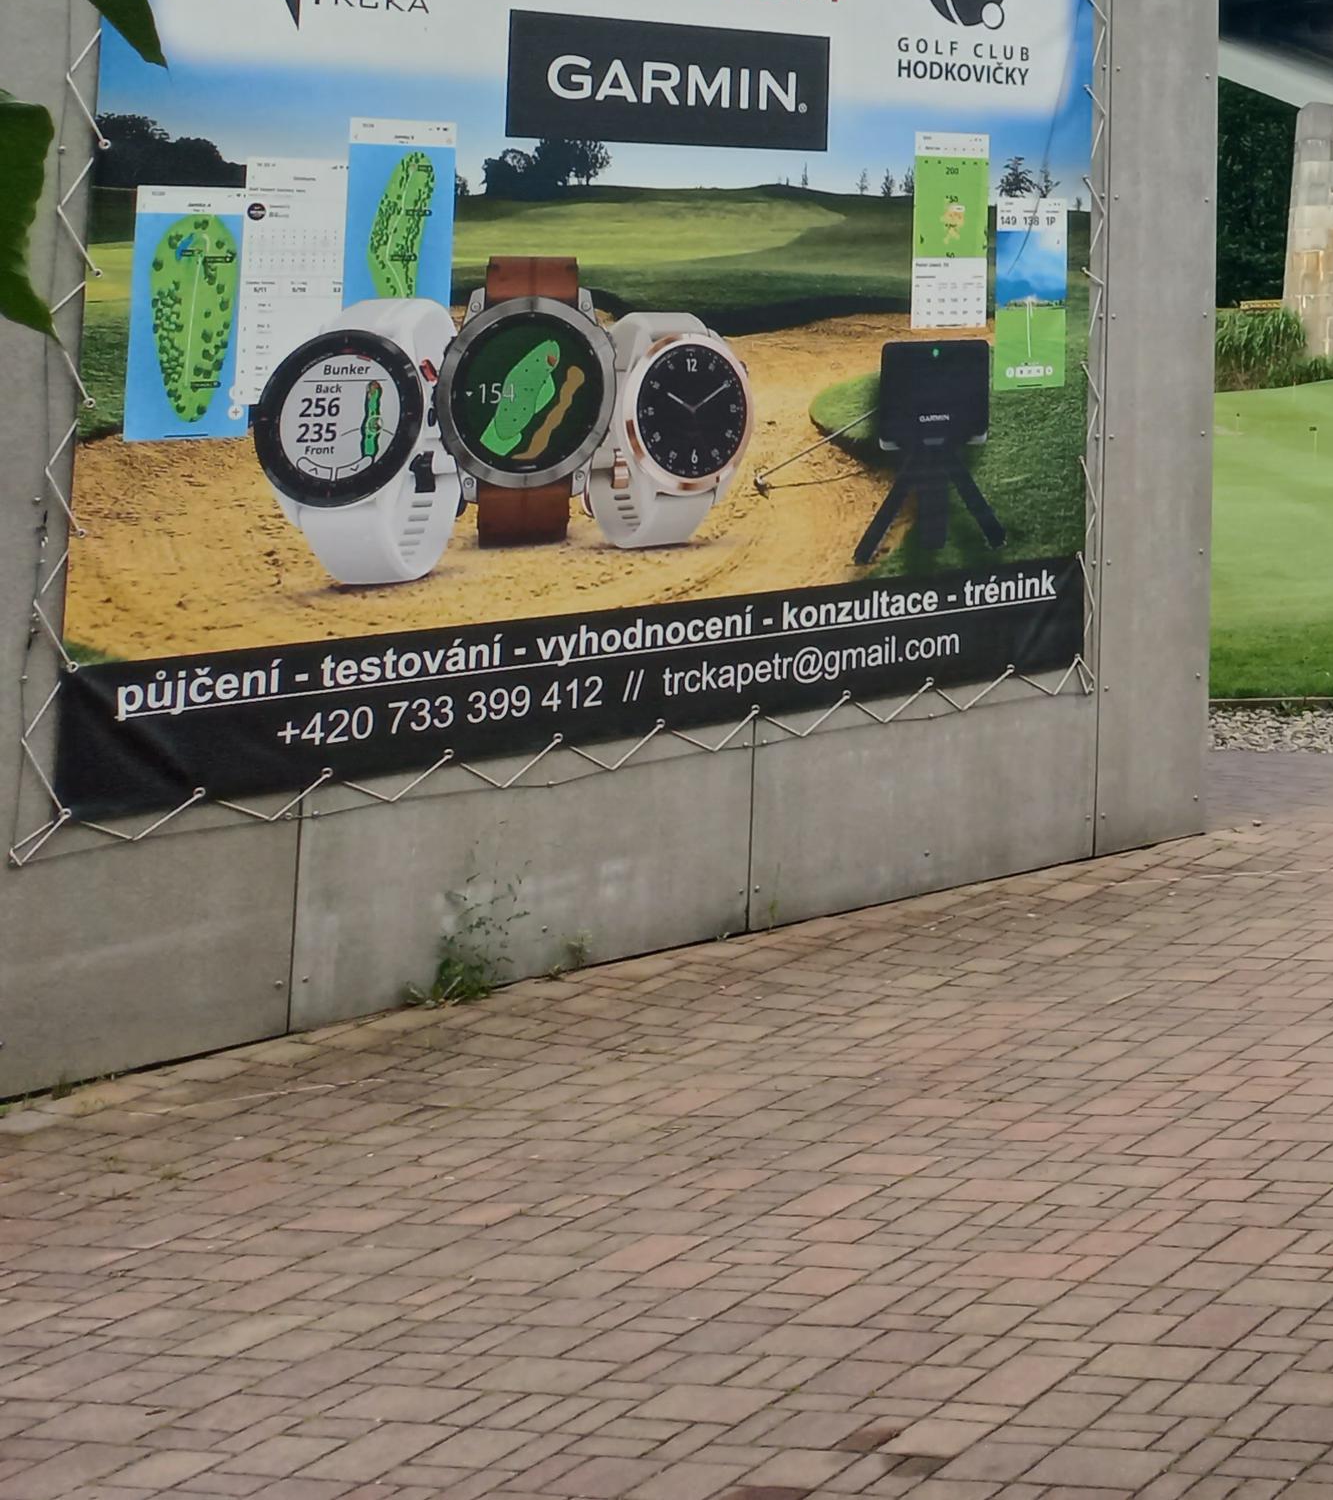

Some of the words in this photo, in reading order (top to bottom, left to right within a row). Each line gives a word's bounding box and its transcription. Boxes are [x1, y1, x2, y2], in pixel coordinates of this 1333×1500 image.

[898, 37, 958, 56] GOLF
[973, 43, 1029, 61] CLUB
[898, 59, 1029, 86] HODKOVIČKY
[547, 54, 798, 113] GARMIN
[1000, 216, 1017, 226] 149
[323, 364, 370, 376] Bunker
[686, 358, 698, 372] 12
[315, 383, 342, 394] Back
[479, 383, 516, 404] 154
[299, 397, 340, 418] 256
[919, 413, 950, 423] GARMIN
[296, 423, 337, 443] 235
[304, 445, 335, 455] Front
[691, 449, 698, 464] 6
[117, 659, 282, 720] půjčení
[321, 634, 502, 689] testování
[536, 605, 753, 667] vyhodnocení
[782, 586, 938, 630] konzultace
[964, 569, 1057, 606] trénink
[276, 706, 373, 747] +420
[388, 695, 454, 734] 733
[466, 685, 530, 725] 399
[541, 676, 604, 713] 412
[662, 633, 960, 697] trckapetr@gmail.com
